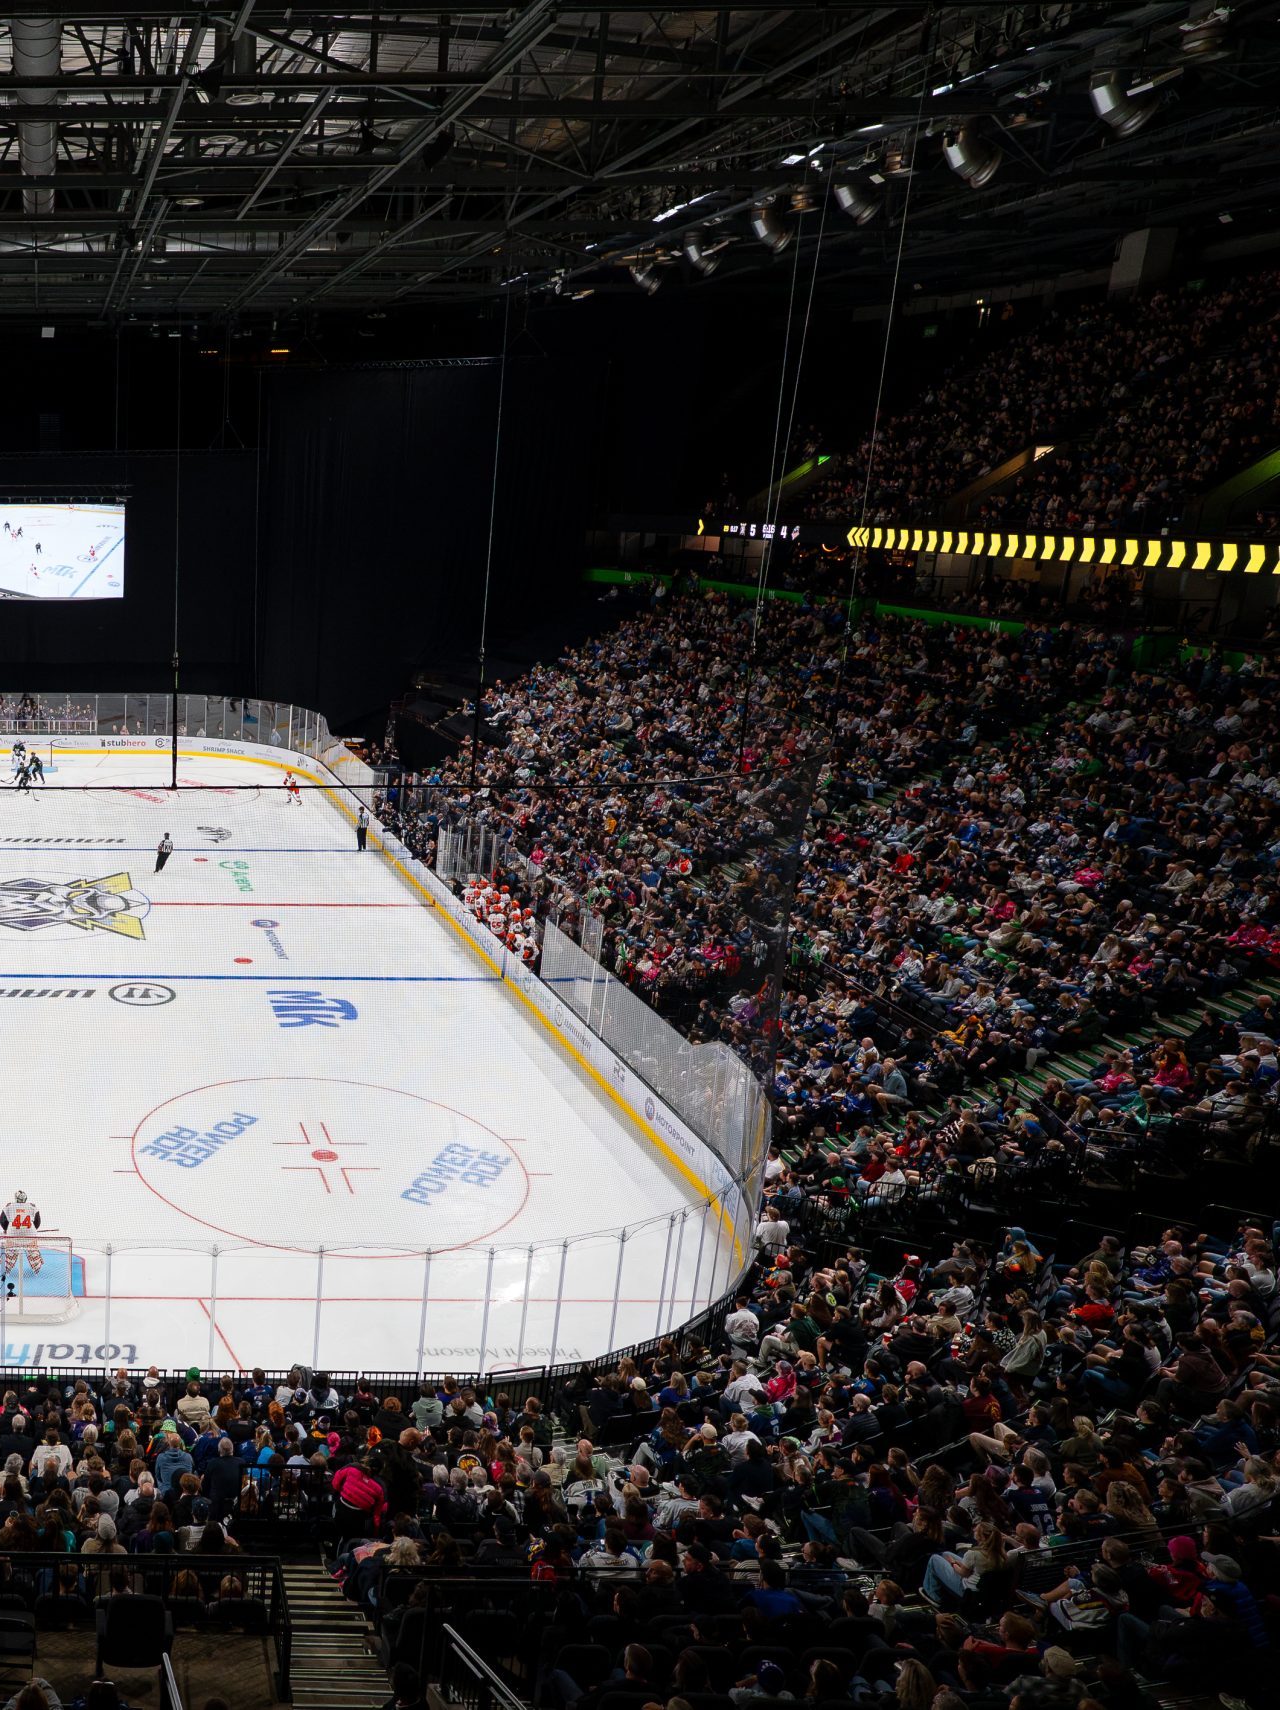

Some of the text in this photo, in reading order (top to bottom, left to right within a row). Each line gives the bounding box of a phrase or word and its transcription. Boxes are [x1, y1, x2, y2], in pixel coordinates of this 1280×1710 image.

[749, 524, 757, 537] 5
[780, 525, 787, 539] 4
[106, 738, 147, 747] stubhero
[203, 745, 245, 755] SHRIMP SHACK
[137, 1124, 200, 1163] ADE
[172, 1111, 259, 1170] POWER
[655, 1111, 696, 1158] MOTORPOINT
[399, 1141, 477, 1207] POWER
[459, 1150, 513, 1190] ADE
[11, 1214, 33, 1230] 44
[415, 1347, 582, 1361] Pinsent Masons
